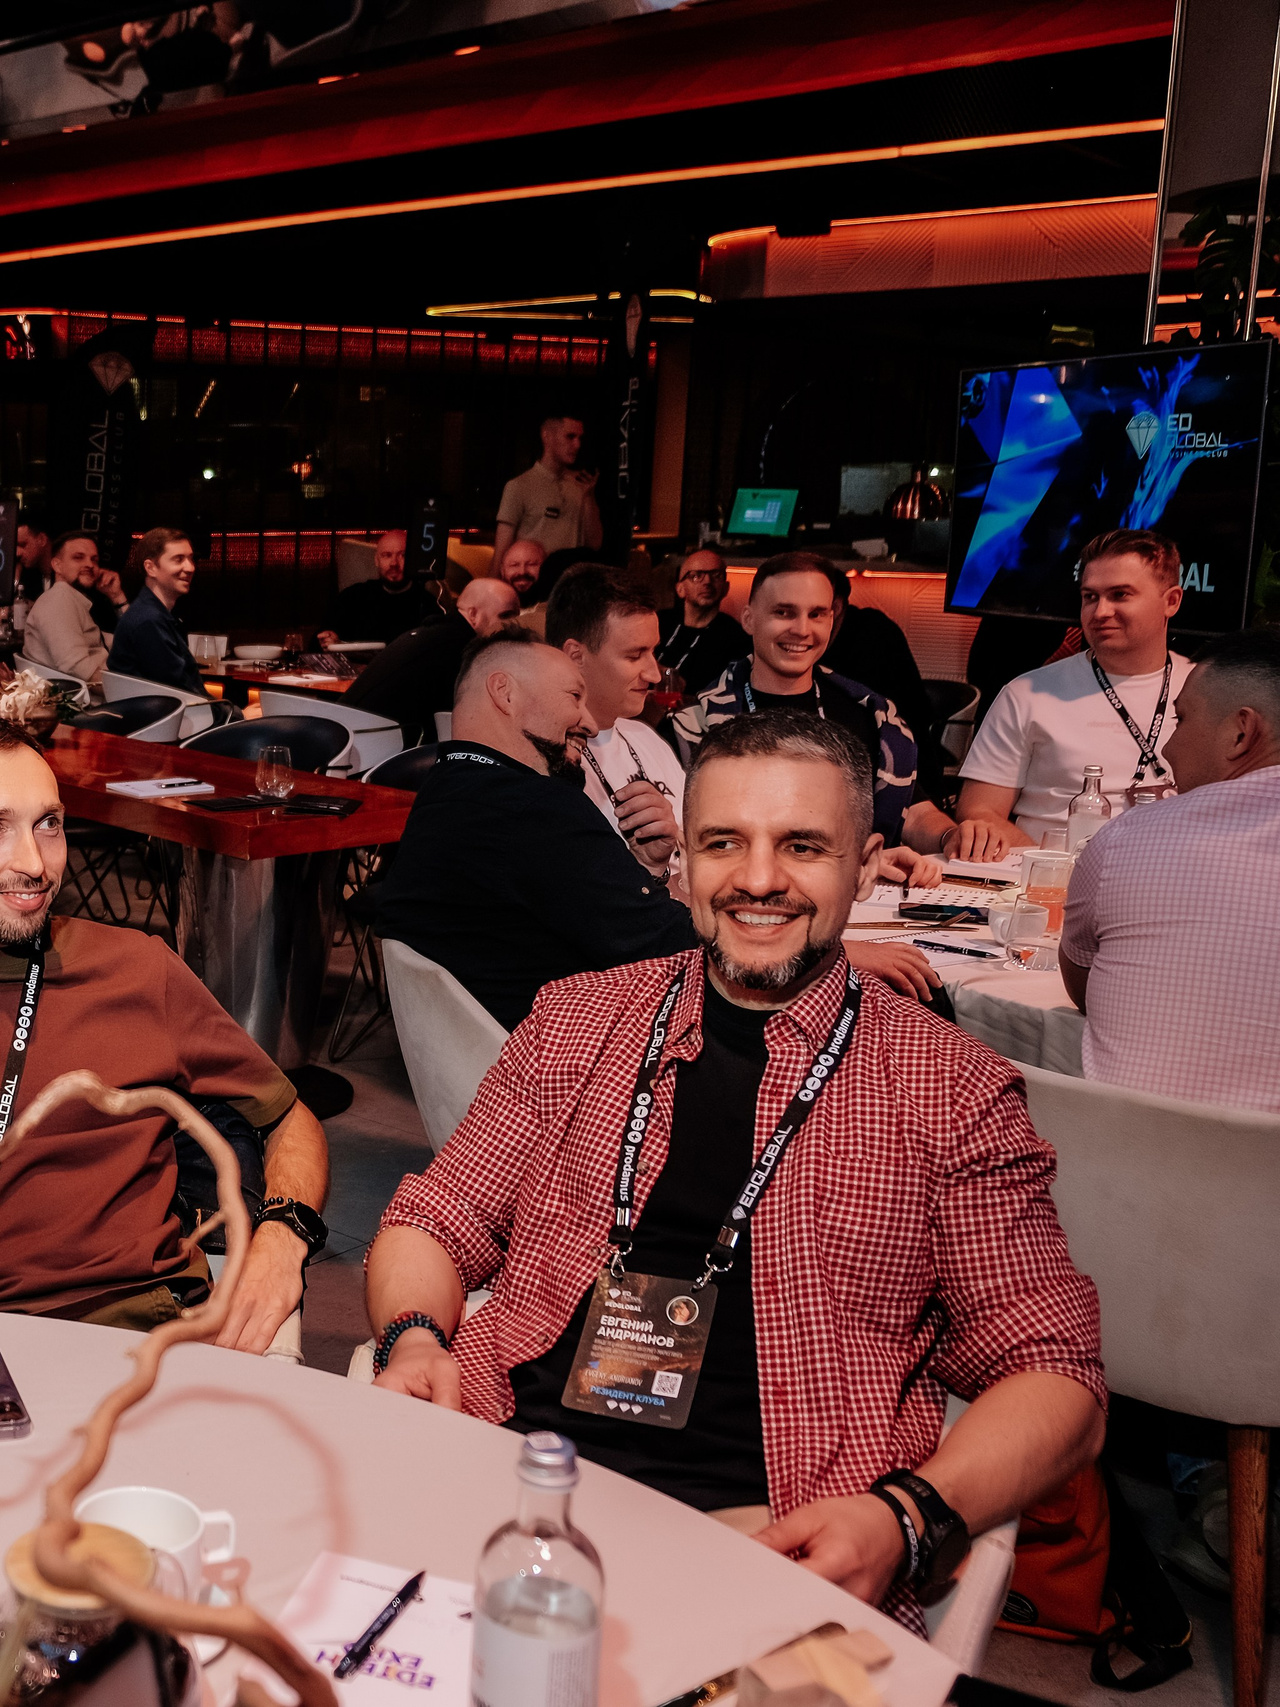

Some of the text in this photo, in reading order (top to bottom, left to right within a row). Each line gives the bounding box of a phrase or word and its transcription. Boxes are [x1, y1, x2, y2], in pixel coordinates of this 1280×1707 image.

[1166, 413, 1193, 432] ED
[81, 409, 109, 532] GLOBAL
[102, 472, 122, 562] USINESS
[421, 524, 435, 552] 5
[583, 747, 606, 784] DGLOBAL
[25, 963, 40, 1004] prodamus
[645, 994, 675, 1069] EDGLOBAL
[827, 1007, 855, 1055] prodamus
[620, 1144, 636, 1202] prodamus
[739, 1124, 793, 1208] EDGLOBAL
[600, 1314, 654, 1333] ЕВГЕНИЙ
[604, 1300, 642, 1313] #EDGLOBAL
[596, 1325, 675, 1348] АНДРИАНОВ
[589, 1386, 666, 1407] РЕЗИДЕНТ КЛУБА
[316, 1650, 436, 1690] EDTEH
